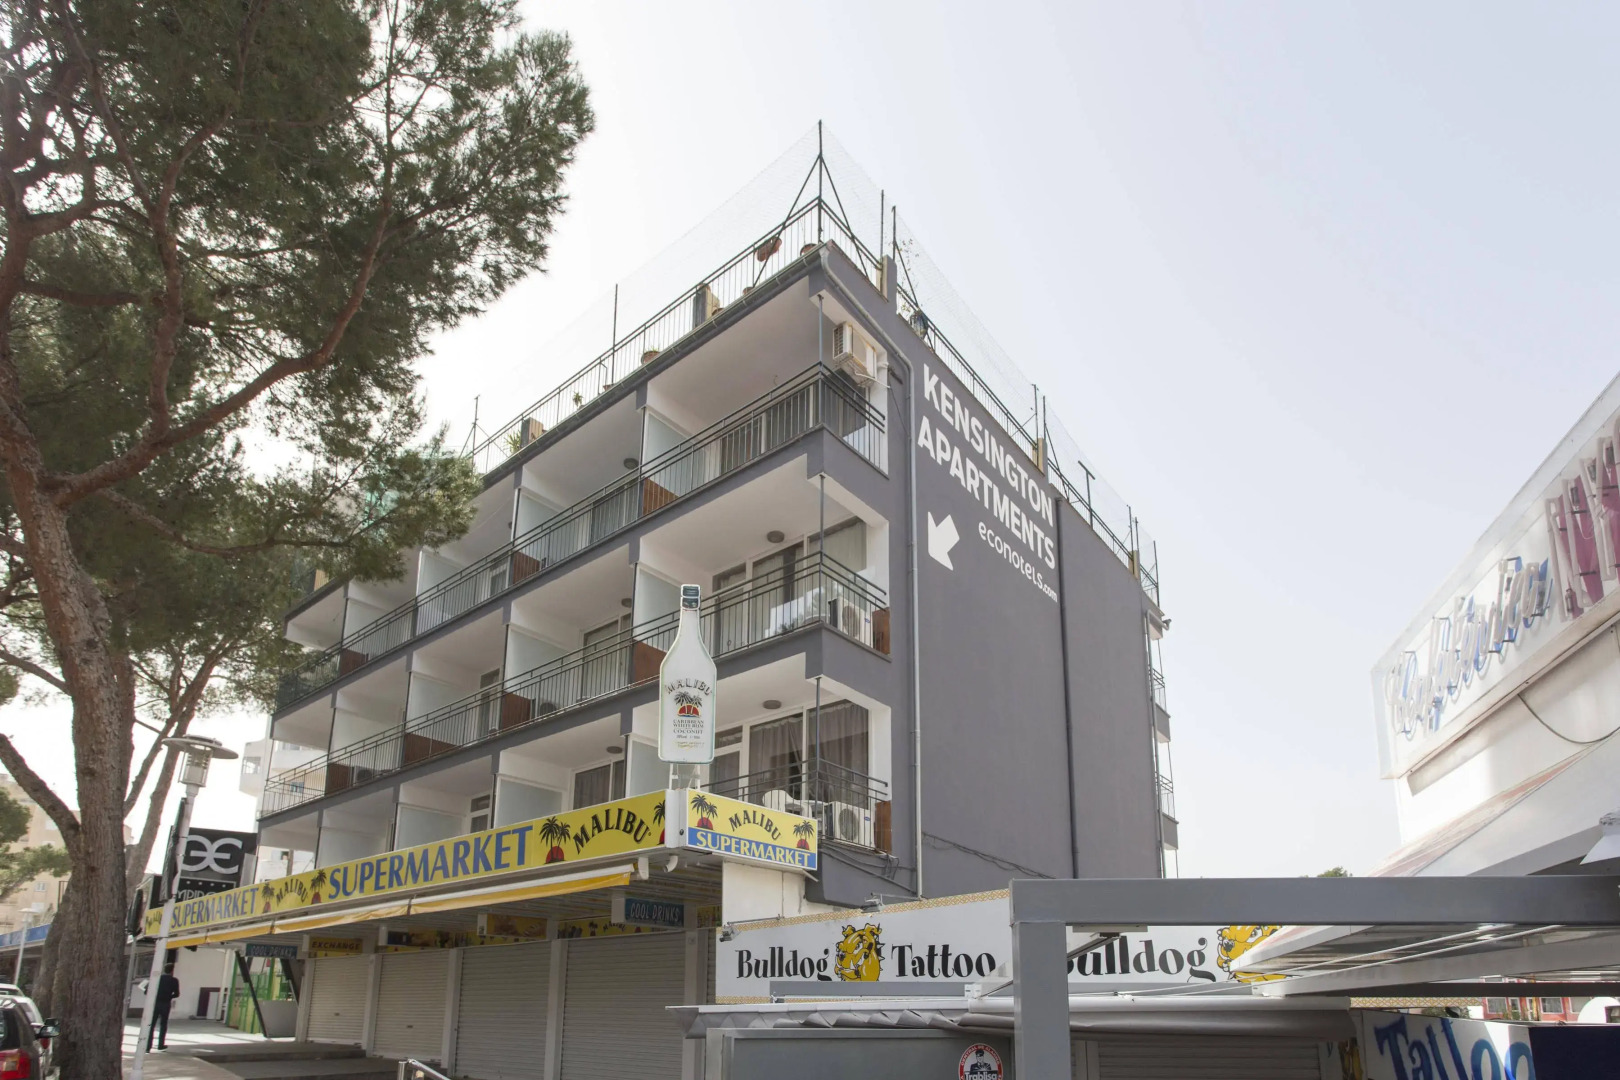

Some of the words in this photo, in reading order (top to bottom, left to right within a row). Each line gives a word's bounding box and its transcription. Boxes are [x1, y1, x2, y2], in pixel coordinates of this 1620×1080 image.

[923, 362, 1053, 528] KENSINGTON
[917, 415, 1056, 570] APARTMENTS
[978, 521, 1058, 603] econotels.com
[665, 678, 711, 696] MALIBU
[573, 807, 650, 855] MALIBU
[728, 809, 781, 841] MALIBU
[328, 825, 533, 900] SUPERMARKET
[696, 831, 811, 867] SUPERMARKET
[171, 887, 259, 929] SUPERMARKET
[276, 878, 309, 906] MALIBU
[630, 902, 649, 919] COOL
[652, 904, 680, 922] DRINKS
[312, 941, 361, 951] EXCHANGE
[736, 946, 833, 982] Bulldog
[891, 944, 996, 978] Tattoo
[964, 1071, 997, 1080] Trablisa
